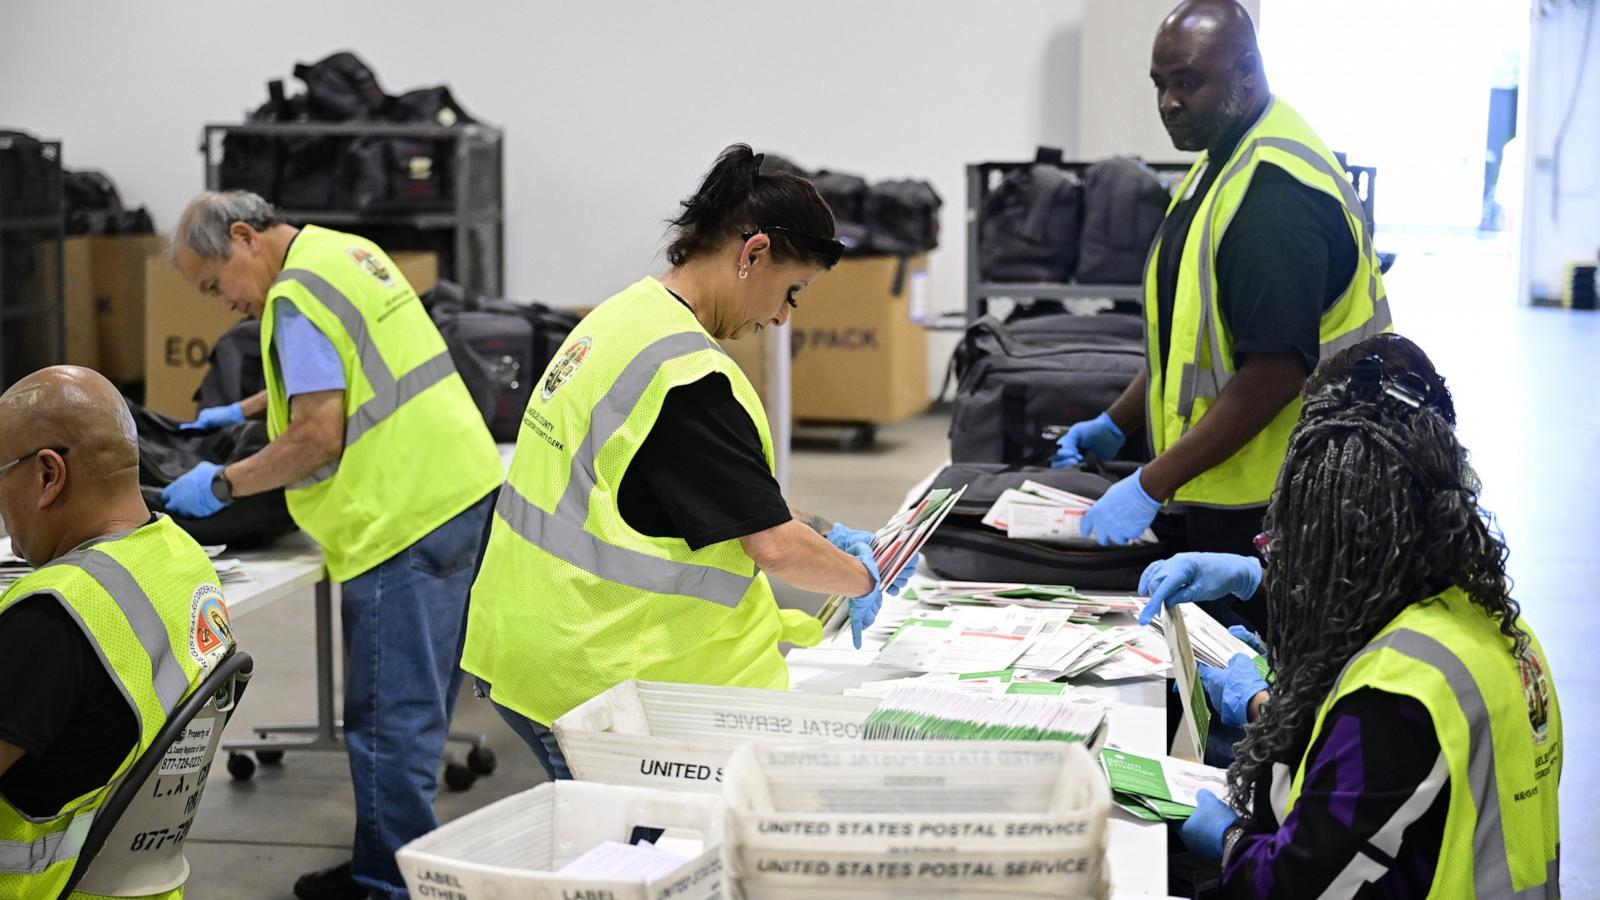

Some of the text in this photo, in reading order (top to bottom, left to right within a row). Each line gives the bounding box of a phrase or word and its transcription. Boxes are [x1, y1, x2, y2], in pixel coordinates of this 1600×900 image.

[548, 437, 564, 450] CLERK
[188, 729, 205, 740] Property
[640, 760, 711, 781] UNITED
[758, 820, 1088, 837] UNITED STATES POSTAL SERVICE
[757, 857, 1088, 878] UNITED STATES POSTAL SERVICE
[417, 869, 463, 888] LABEL
